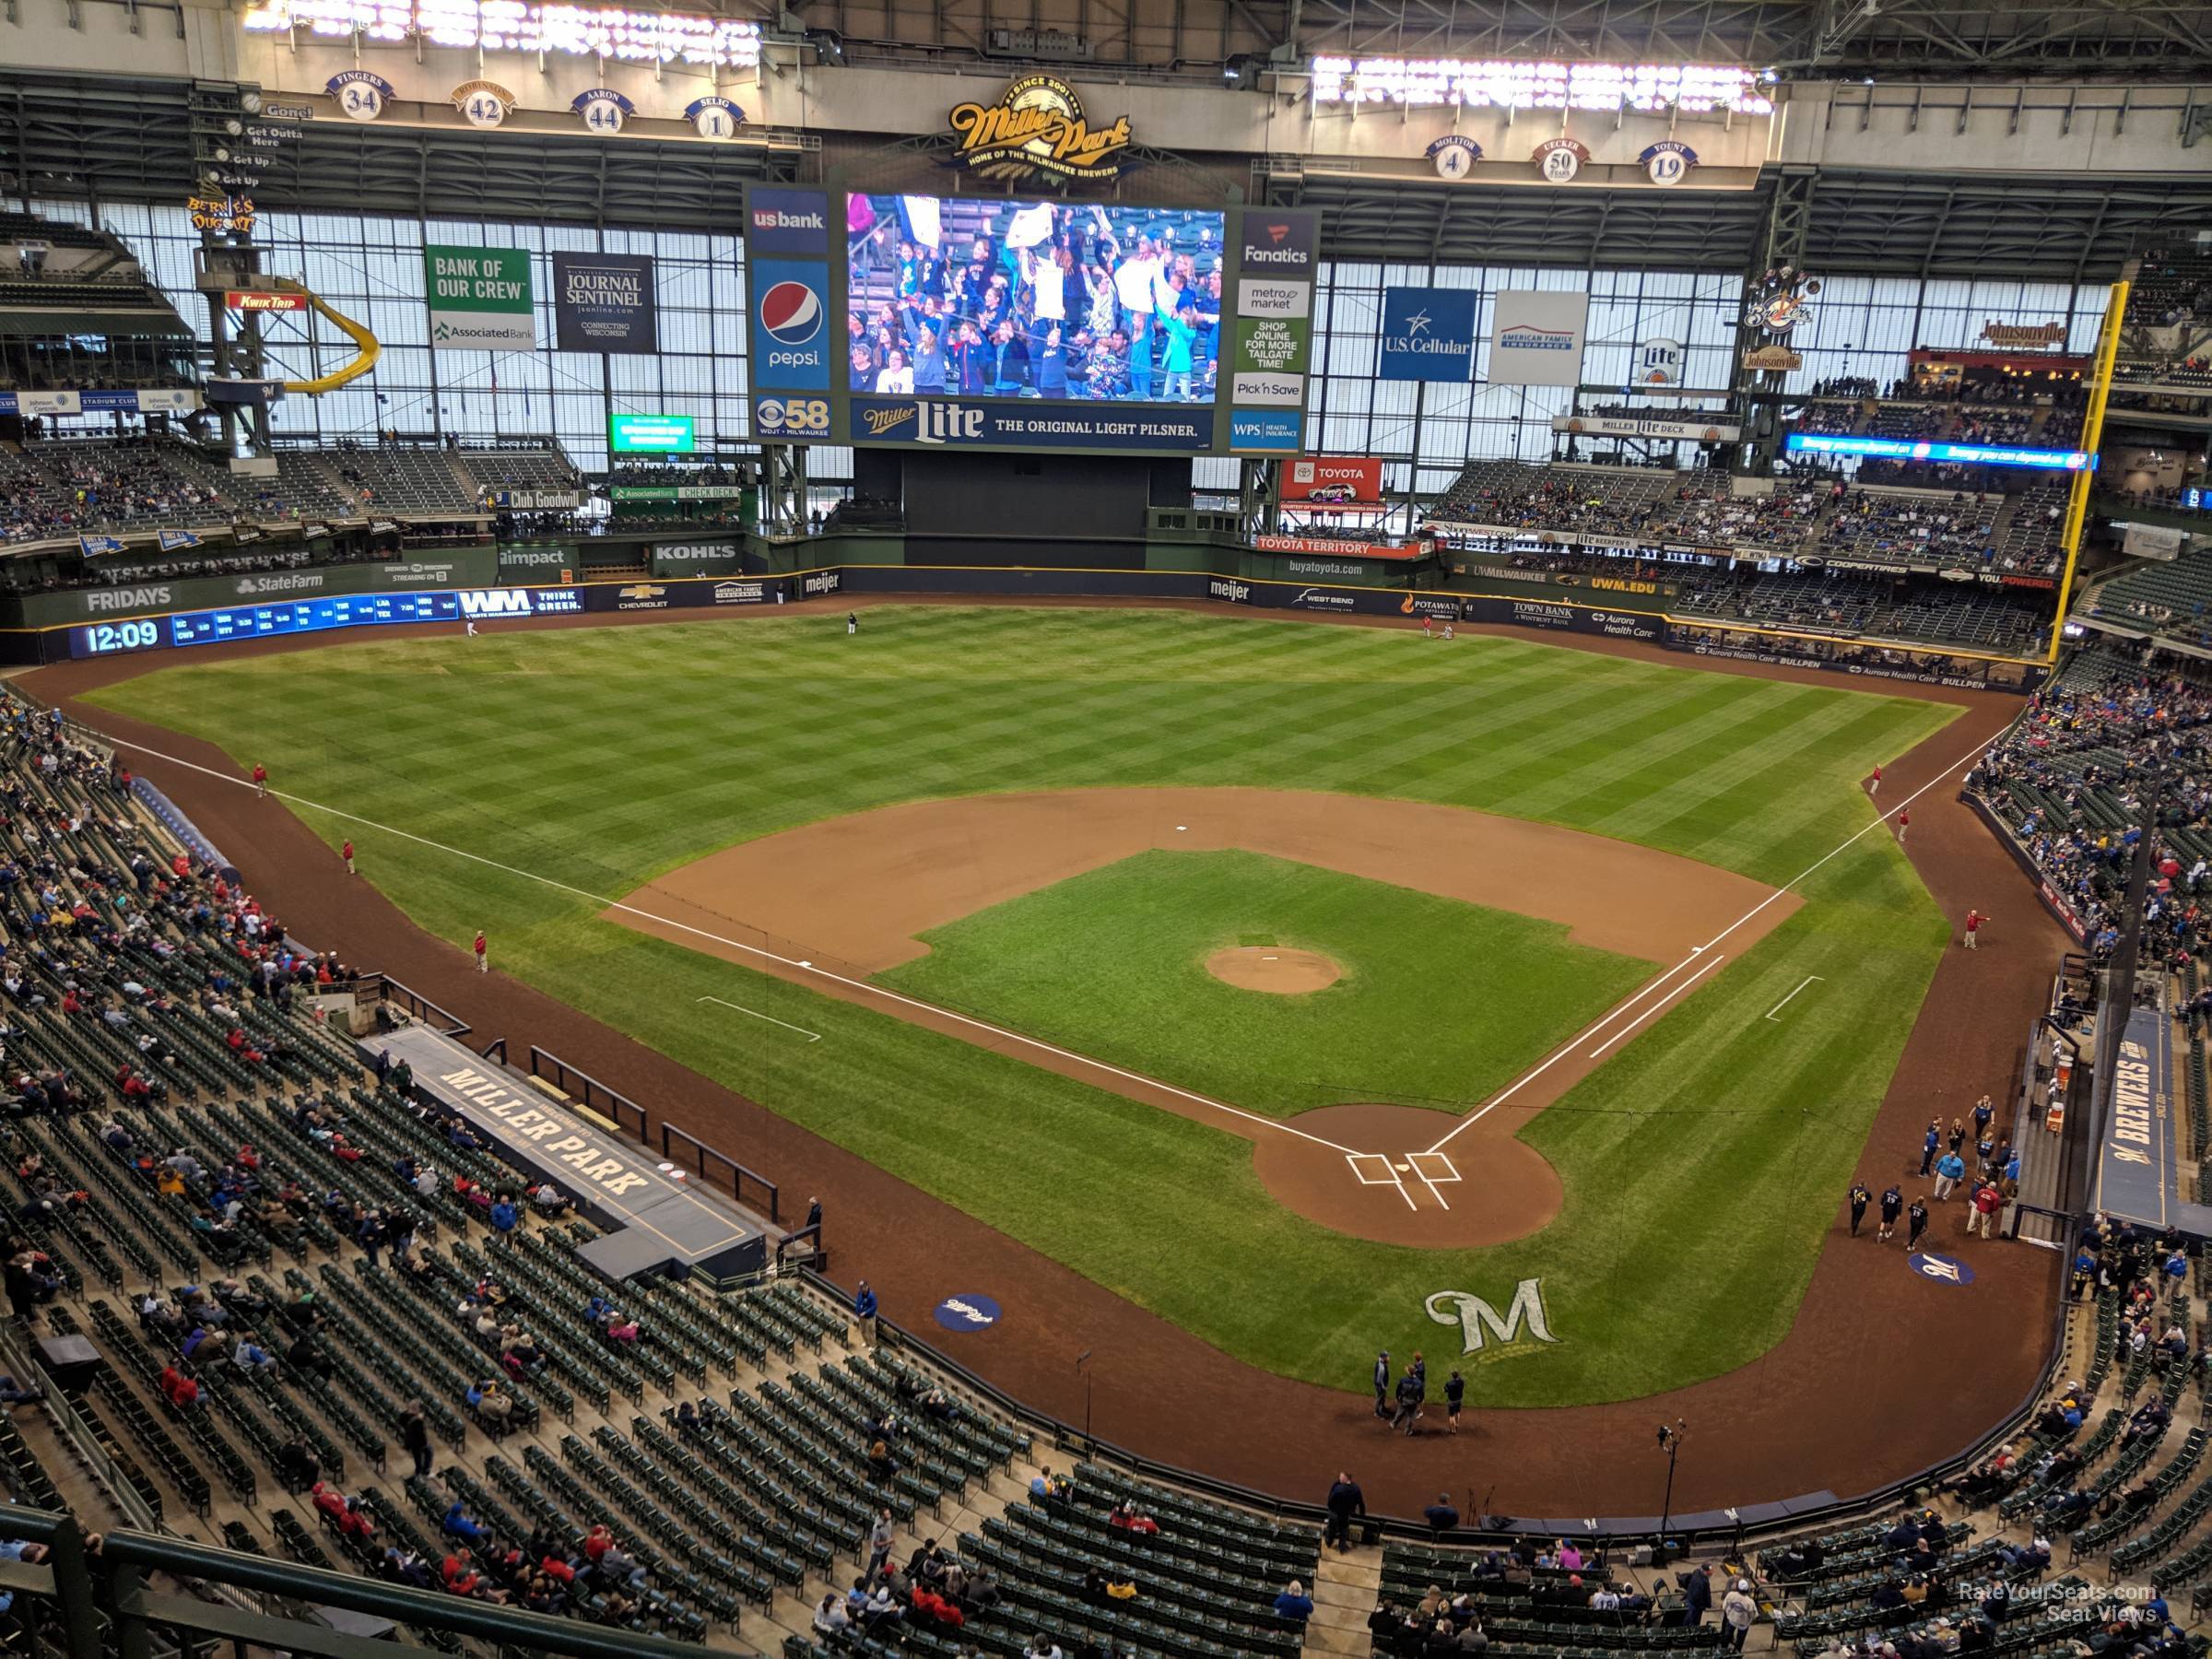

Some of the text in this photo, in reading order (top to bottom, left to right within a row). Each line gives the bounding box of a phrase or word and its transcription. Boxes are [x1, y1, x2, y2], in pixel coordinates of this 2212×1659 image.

[335, 72, 383, 88] FINGERS
[1013, 76, 1071, 96] SINCE 2001
[347, 89, 378, 112] 34
[587, 90, 620, 102] AARON
[700, 98, 730, 108] SELIG
[265, 104, 314, 118] Gone!
[470, 99, 500, 121] 42
[589, 107, 619, 130] 44
[710, 115, 724, 137] 1
[247, 127, 303, 139] Get Outta
[952, 104, 1064, 149] Miller
[252, 137, 280, 147] Here
[1042, 115, 1131, 160] Park
[1434, 137, 1476, 150] MOLITOR
[1544, 141, 1580, 151] UECKER
[1653, 144, 1687, 153] YOUNT
[233, 156, 270, 168] Get Up
[969, 150, 1119, 178] HOME OF THE MILWAUKEE BREWERS
[1445, 152, 1460, 172] 4
[1548, 153, 1572, 171] 50
[1655, 159, 1681, 178] 19
[222, 176, 259, 186] Get Up
[1245, 245, 1308, 264] Fanatics
[435, 257, 502, 278] BANK OF
[437, 279, 522, 300] OUR CREW
[566, 275, 642, 291] JOURNAL
[566, 289, 643, 306] SENTINEL
[1252, 288, 1286, 299] metro
[578, 306, 634, 314] jsonline.com
[1251, 299, 1290, 310] market
[581, 322, 630, 330] CONNECTING
[584, 329, 628, 337] WISCONSIN
[1258, 322, 1287, 331] SHOP
[1979, 319, 2067, 341] Johnsonville
[1253, 331, 1290, 341] ONLINE
[1501, 333, 1543, 341] AMERICAN
[1245, 340, 1299, 350] FOR MORE
[1385, 337, 1470, 355] U.S. Cellular
[769, 350, 820, 368] pepsi
[1249, 349, 1294, 360] TAILGATE
[1643, 347, 1677, 368] Lite
[1746, 354, 1800, 369] Johnsonville
[1257, 359, 1284, 369] TIME!
[1237, 382, 1300, 395] Pick Save
[784, 400, 830, 429] 58
[863, 401, 1198, 444] Miller Lite THE ORIGINAL LIGHT PILSNER.
[1233, 423, 1261, 436] WPS
[1602, 420, 1686, 435] MILLER Lite DECK
[786, 428, 829, 436] MILWAUKEE
[1318, 468, 1364, 479] TOYOTA
[511, 491, 534, 508] Club
[535, 490, 580, 508] Goodwill
[684, 488, 735, 498] CHECK DECK
[655, 545, 736, 560] KOHL'S
[1259, 537, 1371, 553] TOYOTA TERRITORY
[507, 549, 565, 567] impact
[1289, 559, 1363, 575] buyatoyota.com
[392, 574, 427, 582] STREAMING
[806, 572, 840, 594] meijer
[1591, 577, 1656, 594] UWM.EDU
[538, 591, 576, 601] THINK
[1209, 580, 1250, 601] meijer
[87, 586, 172, 611] FRIDAYS
[537, 601, 582, 611] GREEN.
[618, 601, 668, 609] CHEVROLET
[1330, 596, 1355, 605] BEND
[1513, 602, 1573, 618] TOWN BANK
[1520, 615, 1551, 623] WINTRUST
[1554, 618, 1570, 626] BANK
[1606, 614, 1636, 626] Aurora
[87, 621, 159, 653] 12:09
[1604, 623, 1653, 638] Health Care
[1707, 648, 1822, 669] Aurora Health Care BULLPEN
[1863, 667, 1987, 690] Aurora Health Care BULLPEN
[2035, 668, 2050, 677] 345
[2114, 1060, 2150, 1145] BREWERS
[441, 1068, 650, 1196] MILLER PARK
